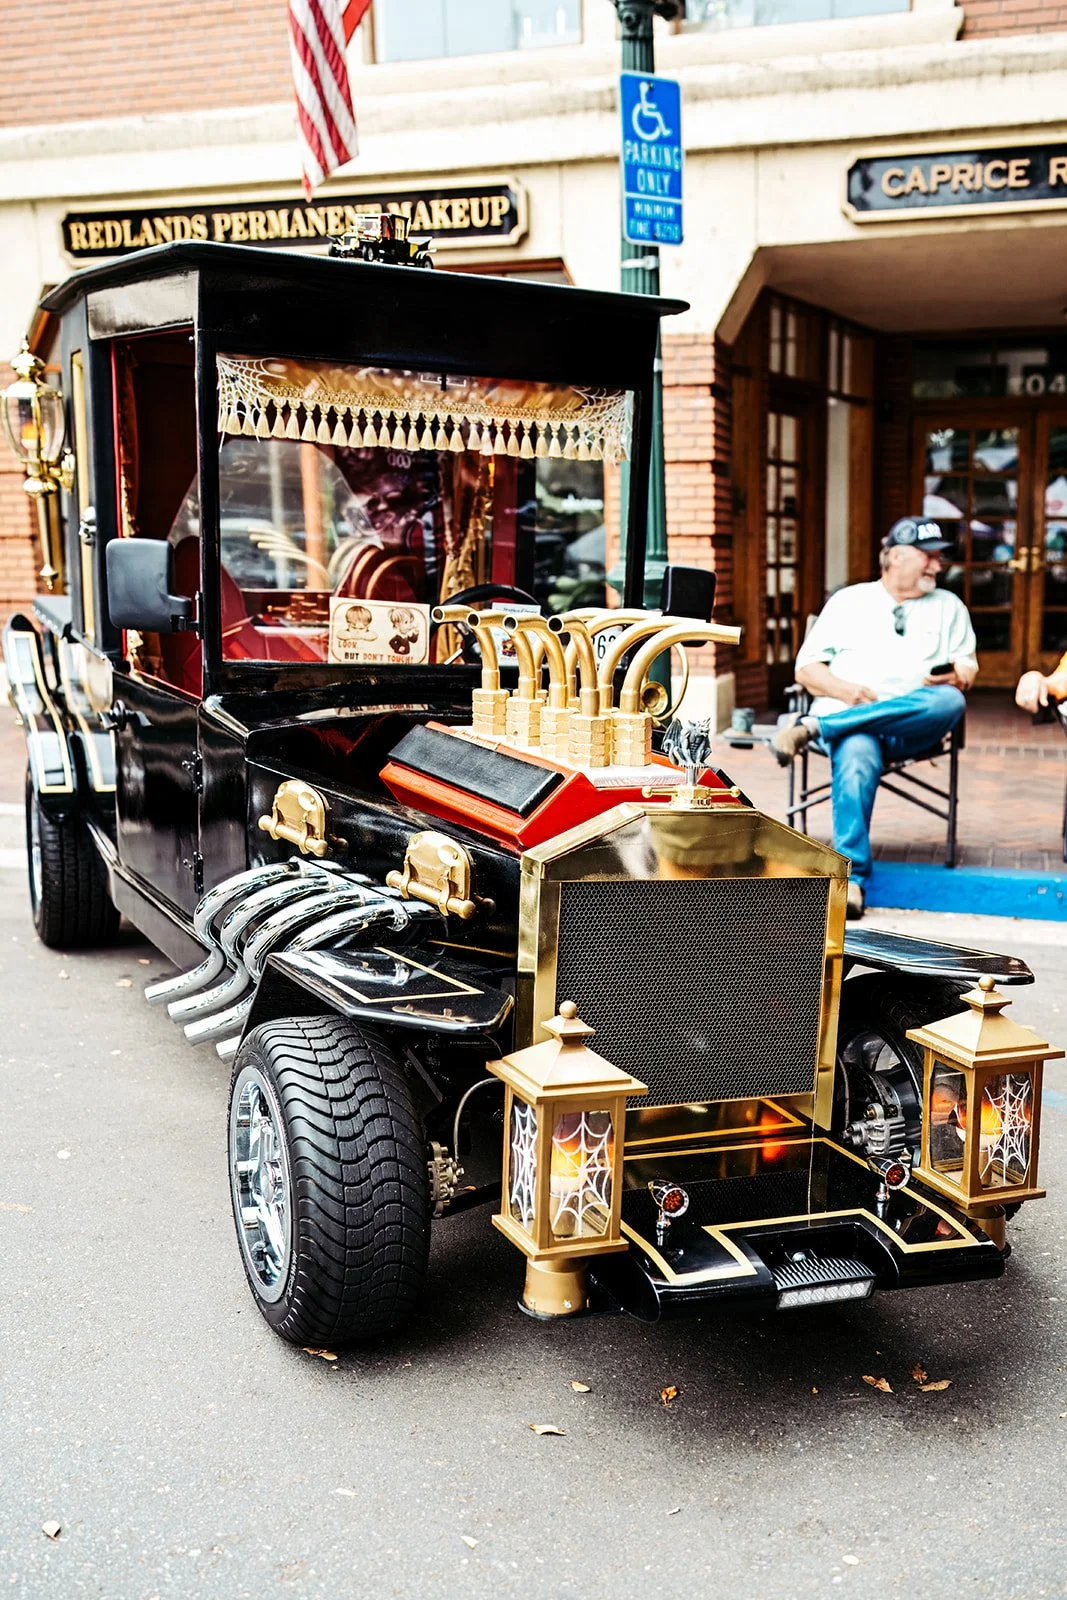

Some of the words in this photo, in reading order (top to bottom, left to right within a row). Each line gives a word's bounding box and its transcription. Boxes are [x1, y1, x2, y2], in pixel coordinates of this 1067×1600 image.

[625, 140, 681, 171] PARKING
[637, 168, 671, 195] ONLY
[881, 158, 1031, 197] CAPRICE
[69, 213, 209, 250] REDLANDS
[386, 196, 511, 231] MAKEUP
[344, 652, 359, 660] BUT
[363, 653, 384, 661] DON'T
[387, 655, 414, 664] TOUCH!
